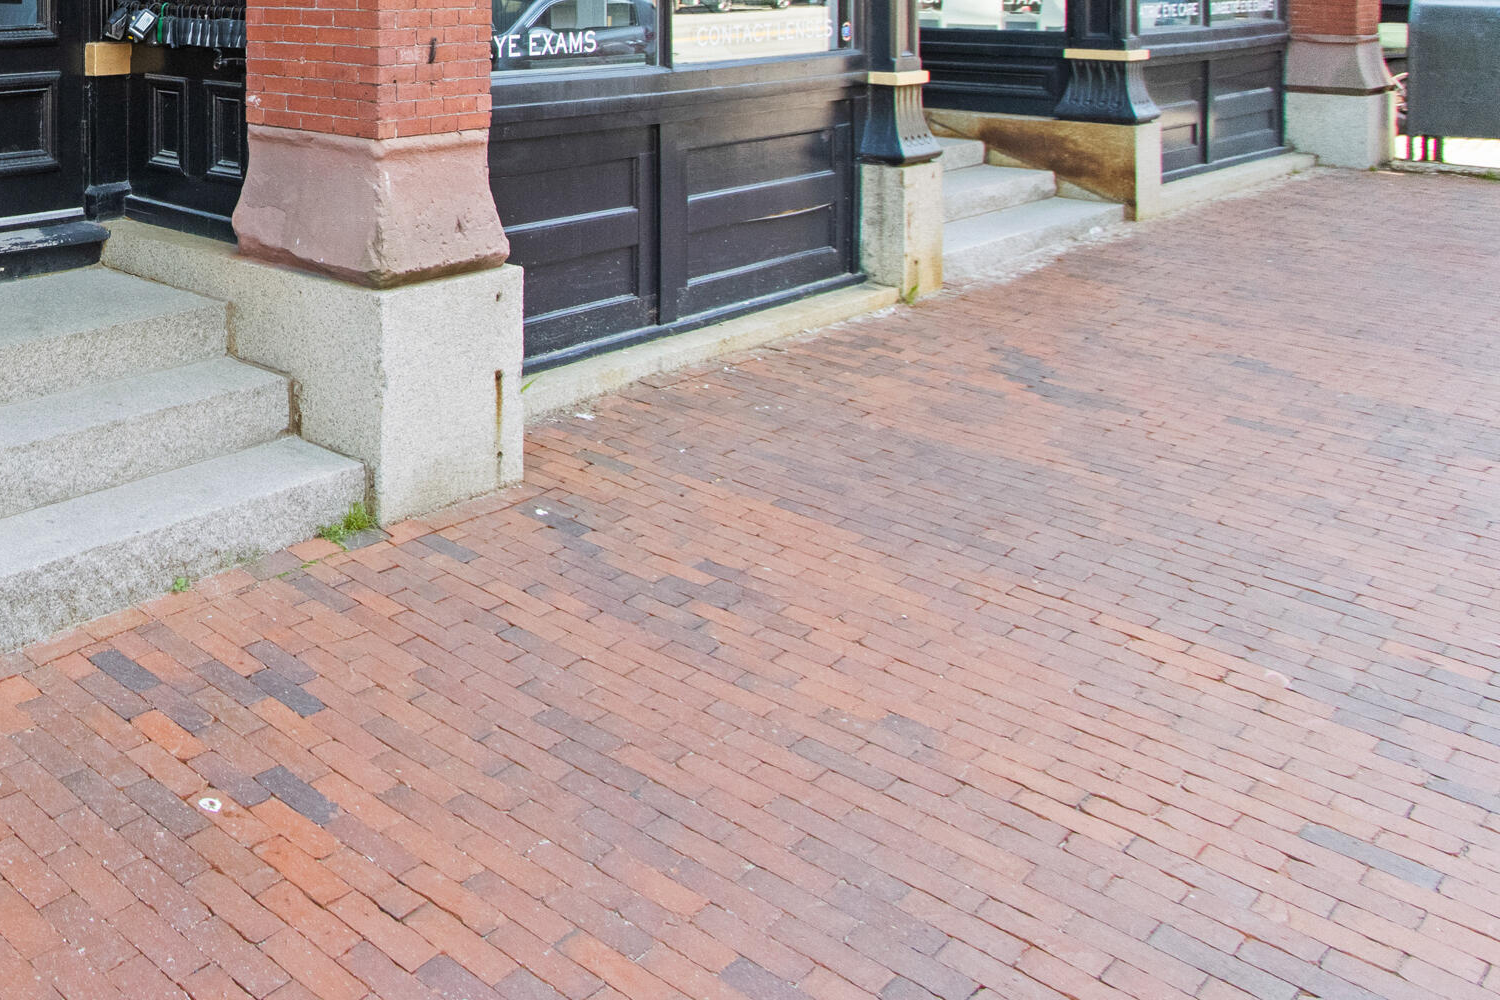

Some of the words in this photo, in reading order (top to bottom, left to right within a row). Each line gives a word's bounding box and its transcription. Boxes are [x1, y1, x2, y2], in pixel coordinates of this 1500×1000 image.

[490, 33, 520, 59] YE
[528, 30, 597, 56] EXAMS
[697, 22, 773, 46] CONTACT
[777, 18, 834, 41] LENSES
